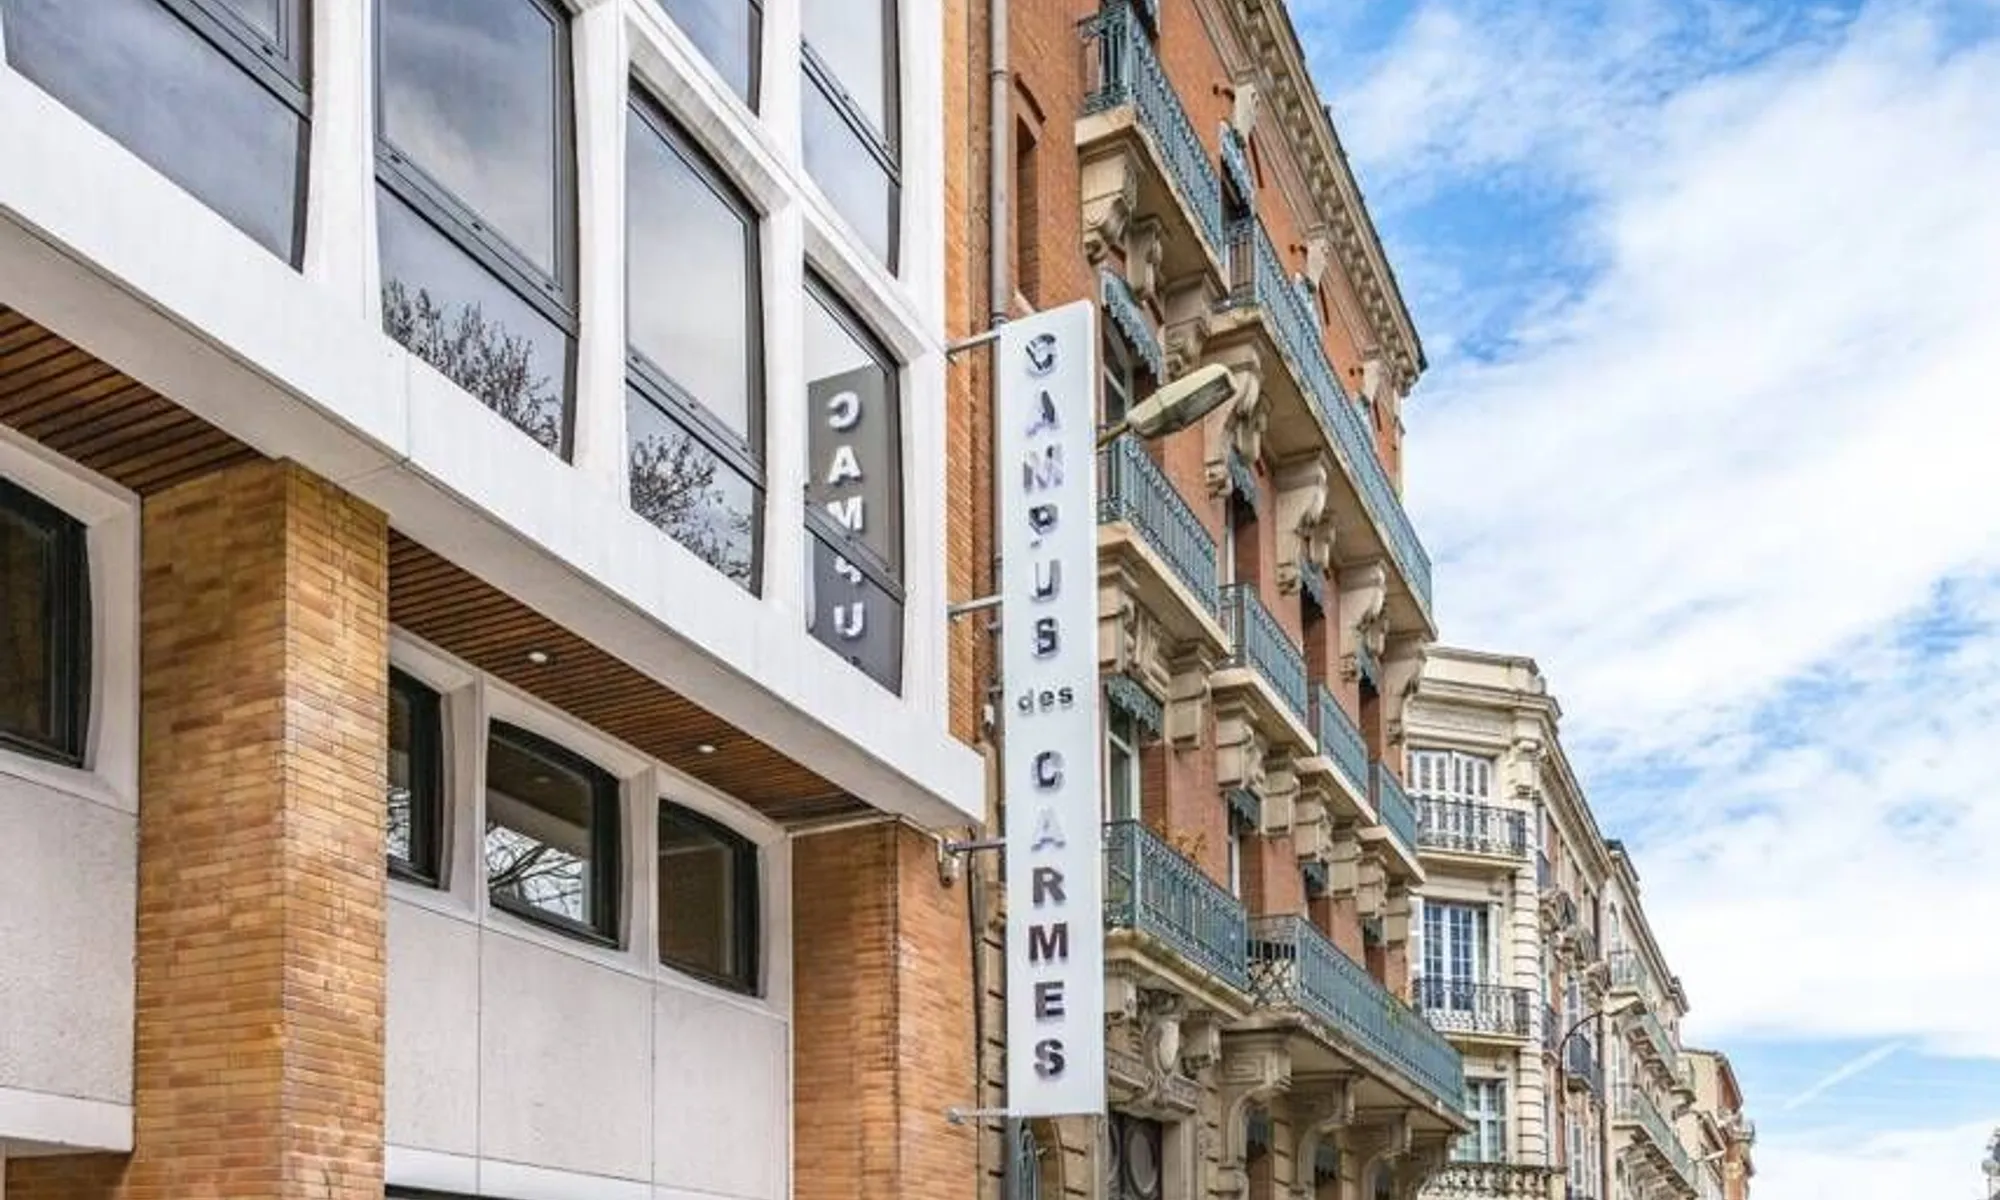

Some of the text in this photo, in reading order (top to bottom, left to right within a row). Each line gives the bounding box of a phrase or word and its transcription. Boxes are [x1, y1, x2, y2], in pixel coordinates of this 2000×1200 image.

[1023, 331, 1064, 659] CAMPUS
[1017, 685, 1074, 716] des
[1028, 750, 1068, 1080] CARMES
